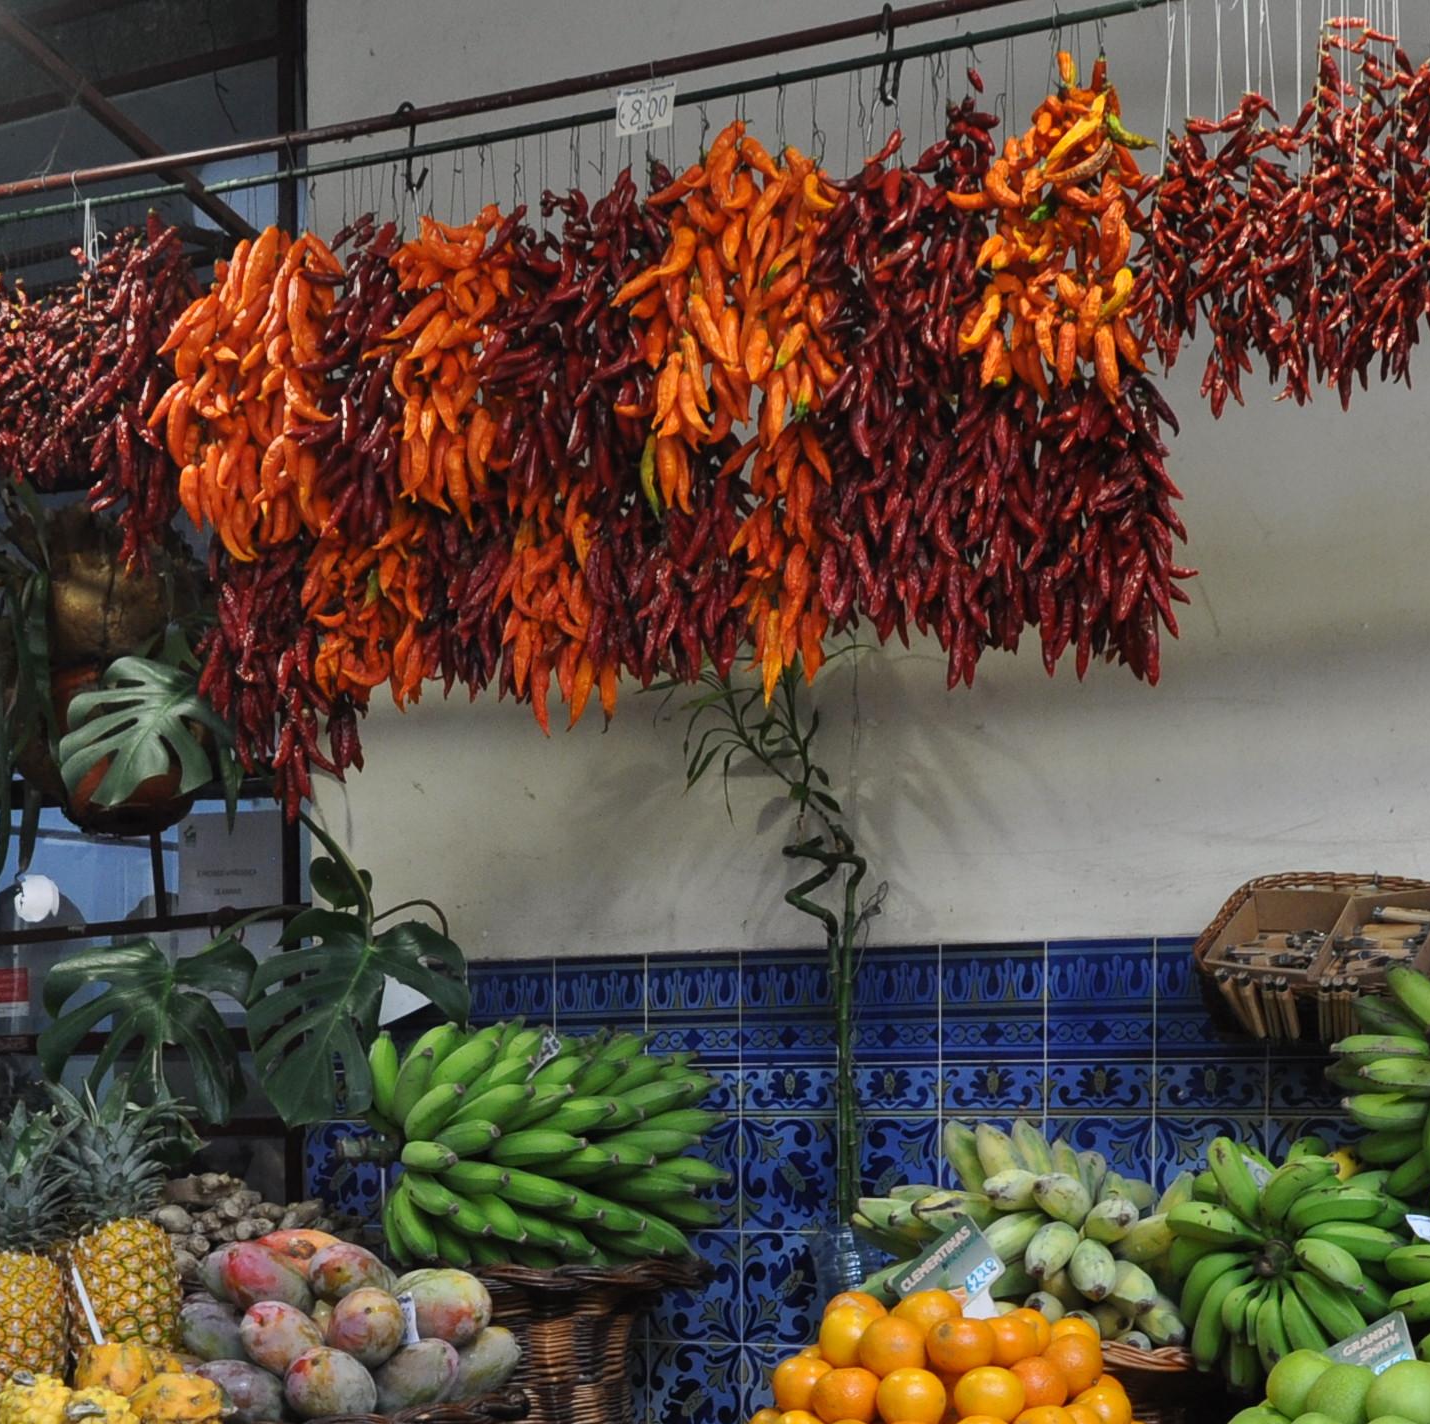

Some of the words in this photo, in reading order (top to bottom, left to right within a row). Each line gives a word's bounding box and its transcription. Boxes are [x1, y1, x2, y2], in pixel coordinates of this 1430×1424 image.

[900, 1225, 971, 1293] CLEMENTINAS
[1343, 1319, 1396, 1358] GRANNY
[1359, 1332, 1401, 1362] SMITH
